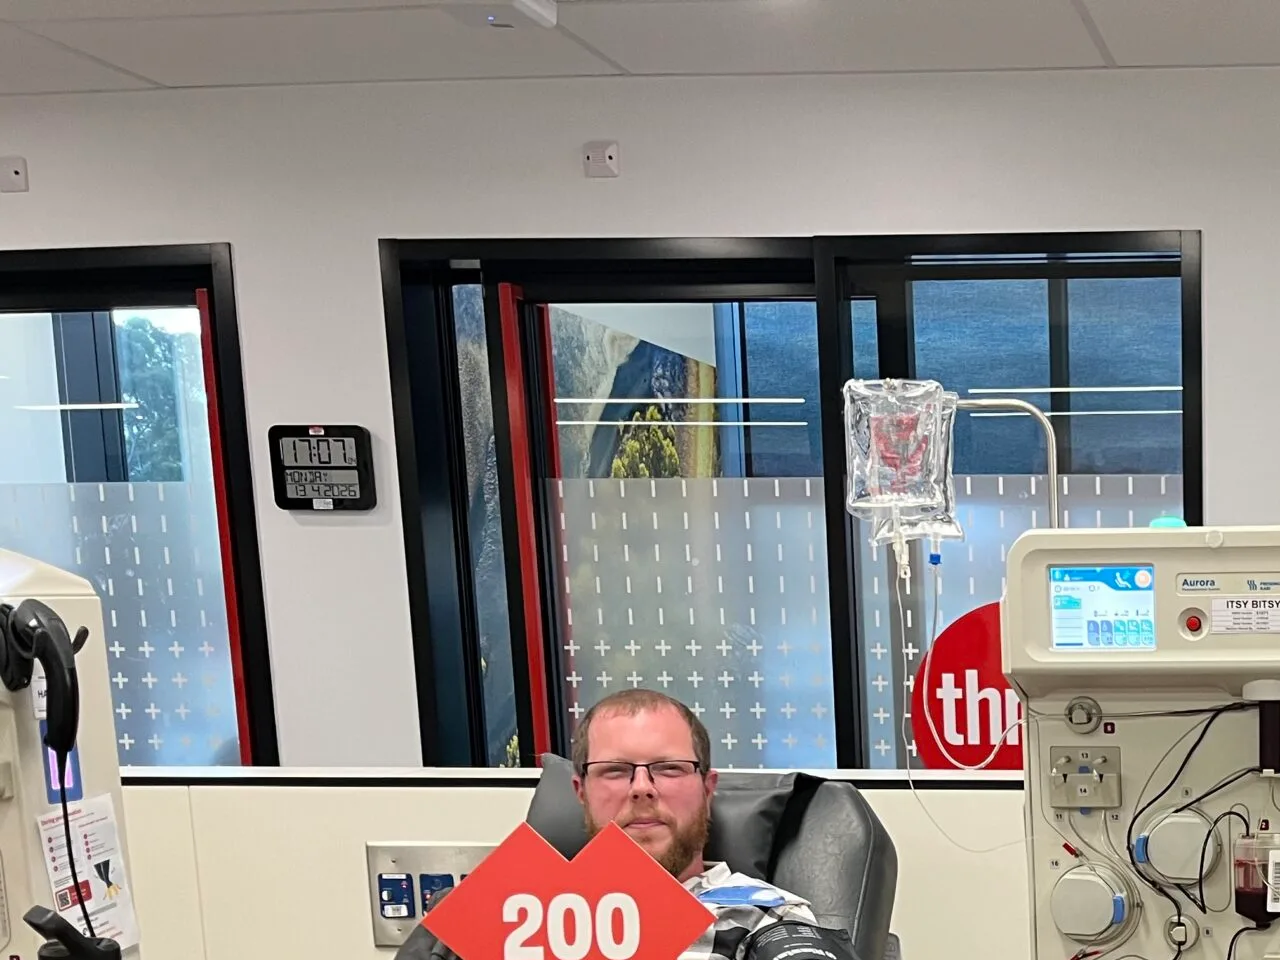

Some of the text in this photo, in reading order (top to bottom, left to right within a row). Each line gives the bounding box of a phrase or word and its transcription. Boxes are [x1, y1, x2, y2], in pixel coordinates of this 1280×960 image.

[293, 439, 347, 464] 17:07
[285, 471, 328, 483] MONDAY
[1182, 579, 1215, 587] Aurora
[1226, 600, 1280, 609] ITSY BITSY
